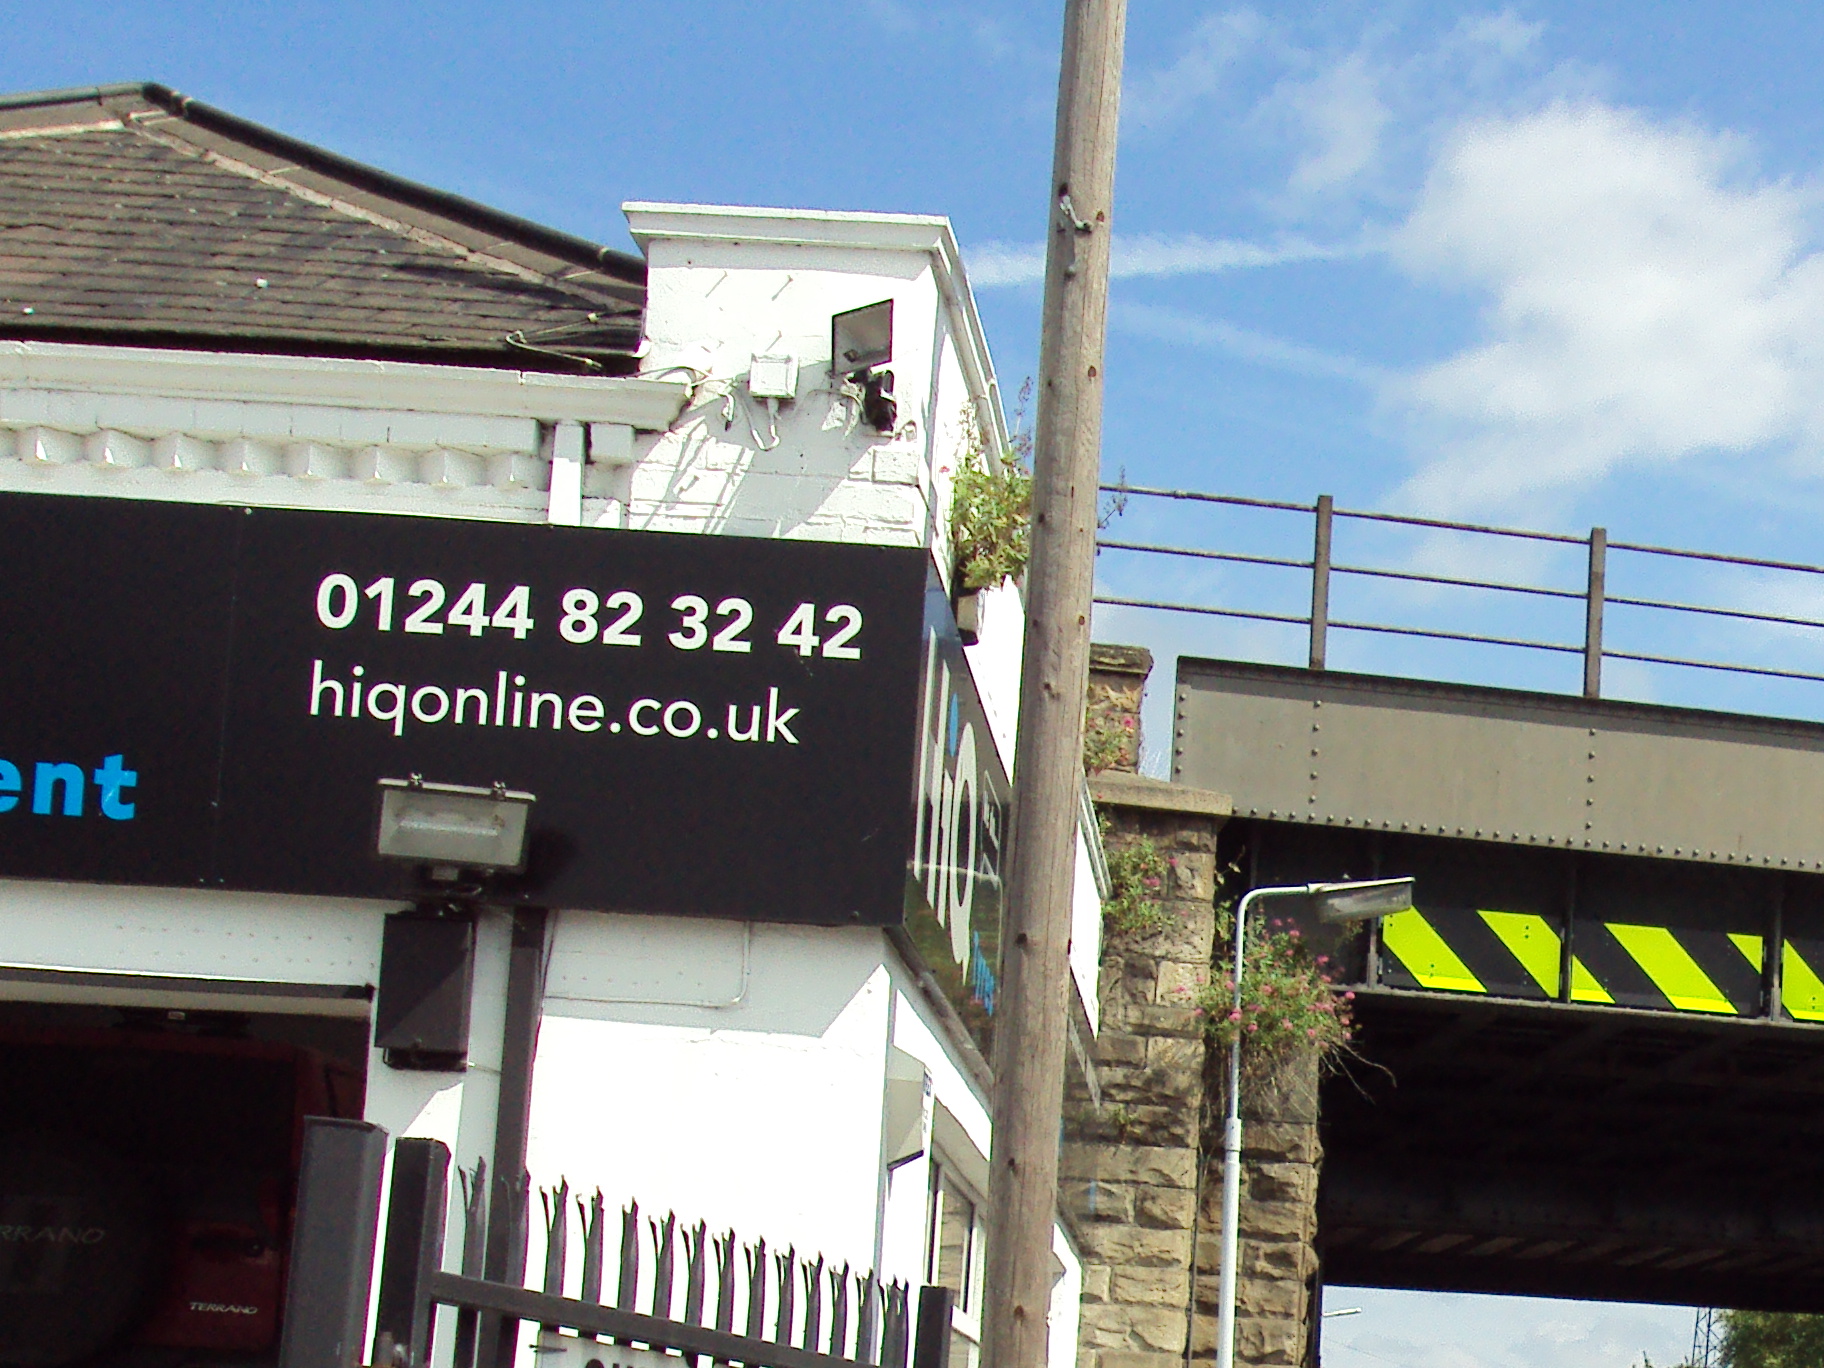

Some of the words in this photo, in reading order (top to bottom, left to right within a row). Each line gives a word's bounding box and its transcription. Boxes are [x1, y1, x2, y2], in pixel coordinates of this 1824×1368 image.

[316, 573, 534, 640] 01244
[559, 588, 644, 648] 82
[668, 595, 754, 653] 32
[777, 603, 863, 660] 42
[310, 659, 800, 744] hiqonline.co.uk
[190, 1302, 258, 1315] TERRANO
